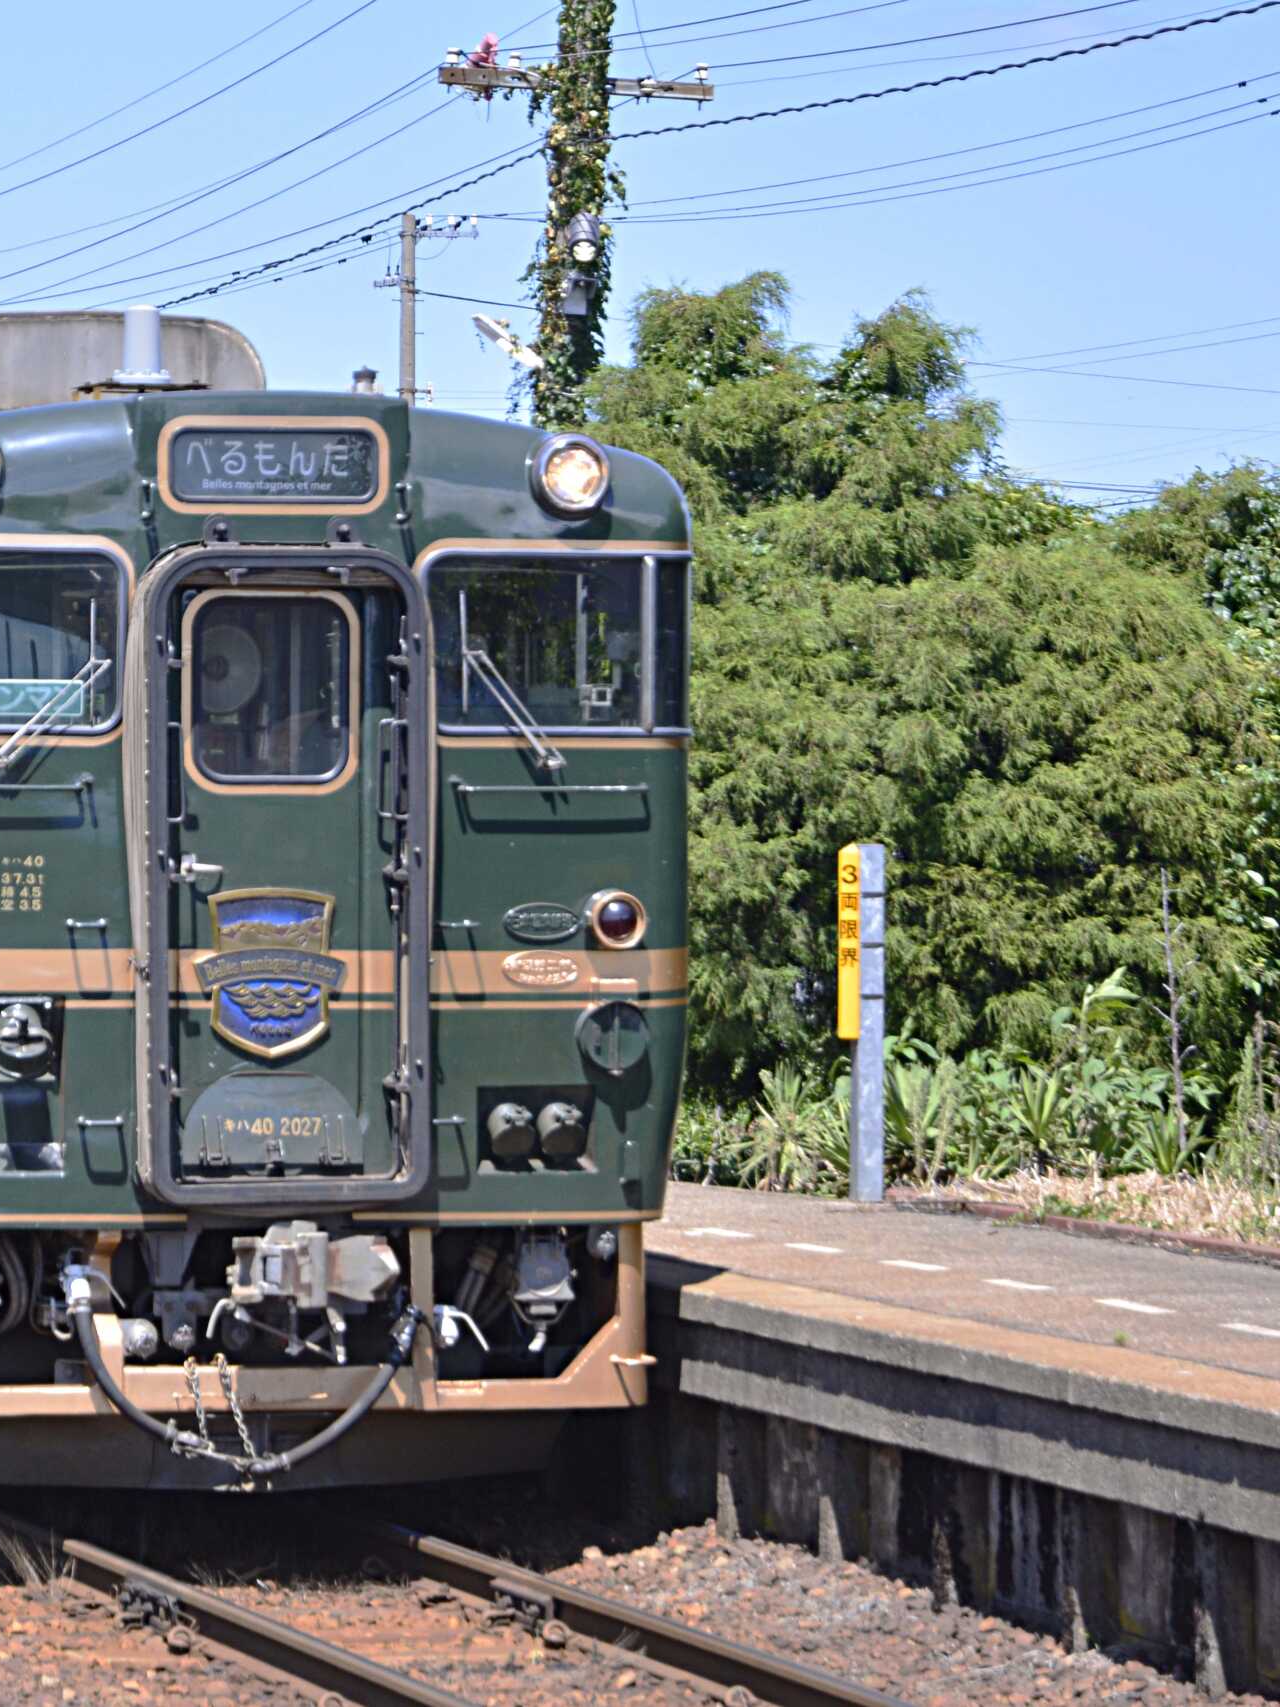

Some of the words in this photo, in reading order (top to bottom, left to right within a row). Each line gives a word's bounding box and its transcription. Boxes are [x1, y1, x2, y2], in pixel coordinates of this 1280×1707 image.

[186, 438, 349, 477] べるもんた
[202, 479, 233, 489] Belles
[235, 479, 295, 492] montagnes
[296, 479, 308, 489] et
[310, 480, 333, 490] mer
[1, 855, 45, 867] キハ40
[1, 872, 45, 884] 37.3t
[19, 887, 42, 897] 4.5
[19, 900, 42, 911] 3.5
[840, 864, 859, 968] 3両限界
[224, 1116, 275, 1136] キハ40
[280, 1116, 322, 1136] 2027
